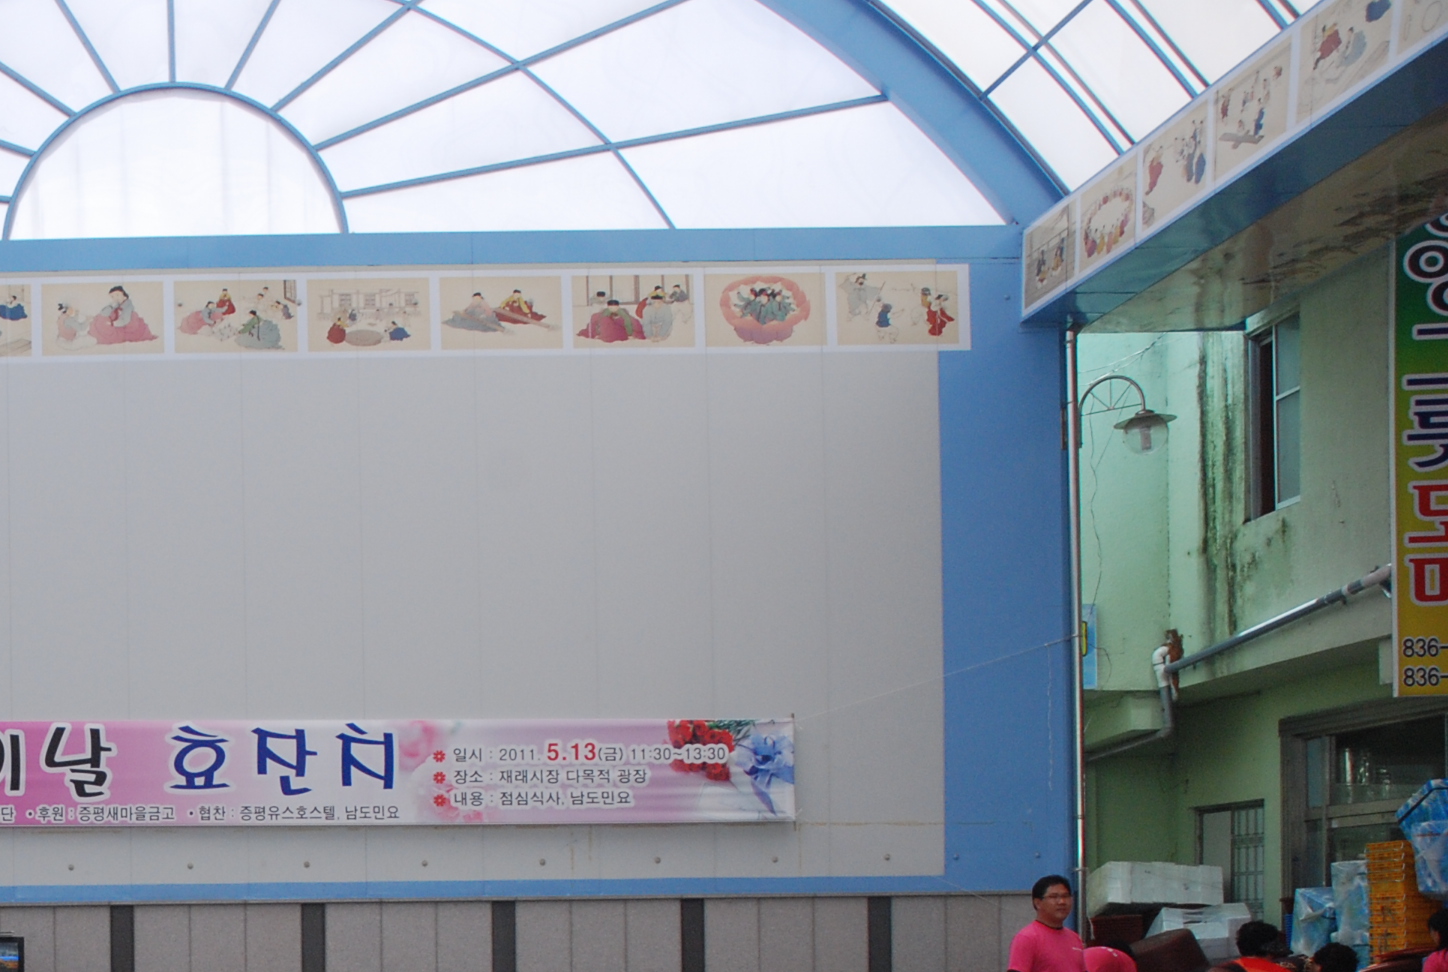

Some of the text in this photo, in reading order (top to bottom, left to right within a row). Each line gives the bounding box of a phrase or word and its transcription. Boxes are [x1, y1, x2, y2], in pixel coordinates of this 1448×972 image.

[630, 746, 727, 761] 11:30~13:30
[498, 769, 560, 784] 재래시장
[566, 768, 611, 784] 다목적
[617, 768, 648, 784] 광장
[570, 790, 632, 806] 남도민요
[78, 805, 175, 822] 증평새마을금고
[344, 805, 400, 820] 남도민요
